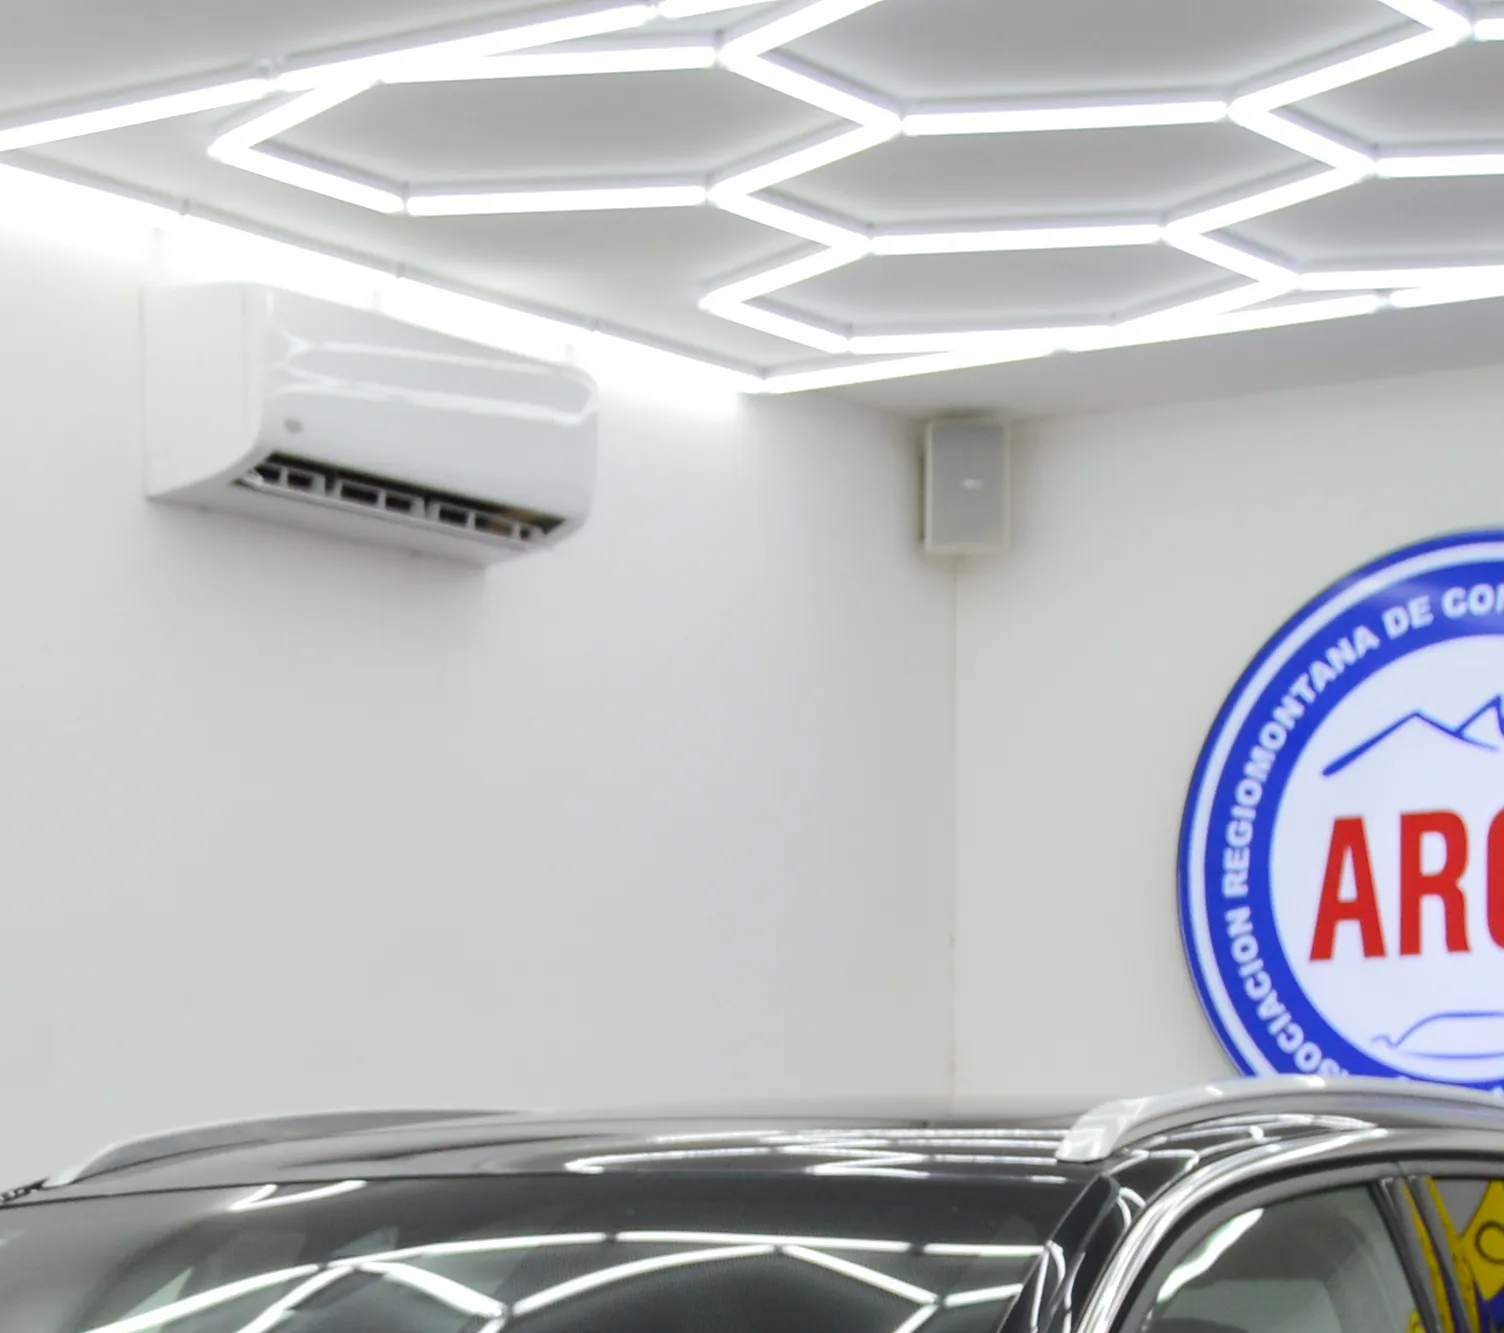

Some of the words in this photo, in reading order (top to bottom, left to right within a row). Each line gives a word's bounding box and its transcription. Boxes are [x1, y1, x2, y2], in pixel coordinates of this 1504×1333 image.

[1382, 595, 1435, 640] DE
[1221, 624, 1381, 898] REGIOMONTANA
[1224, 906, 1350, 1077] SOCIACION
